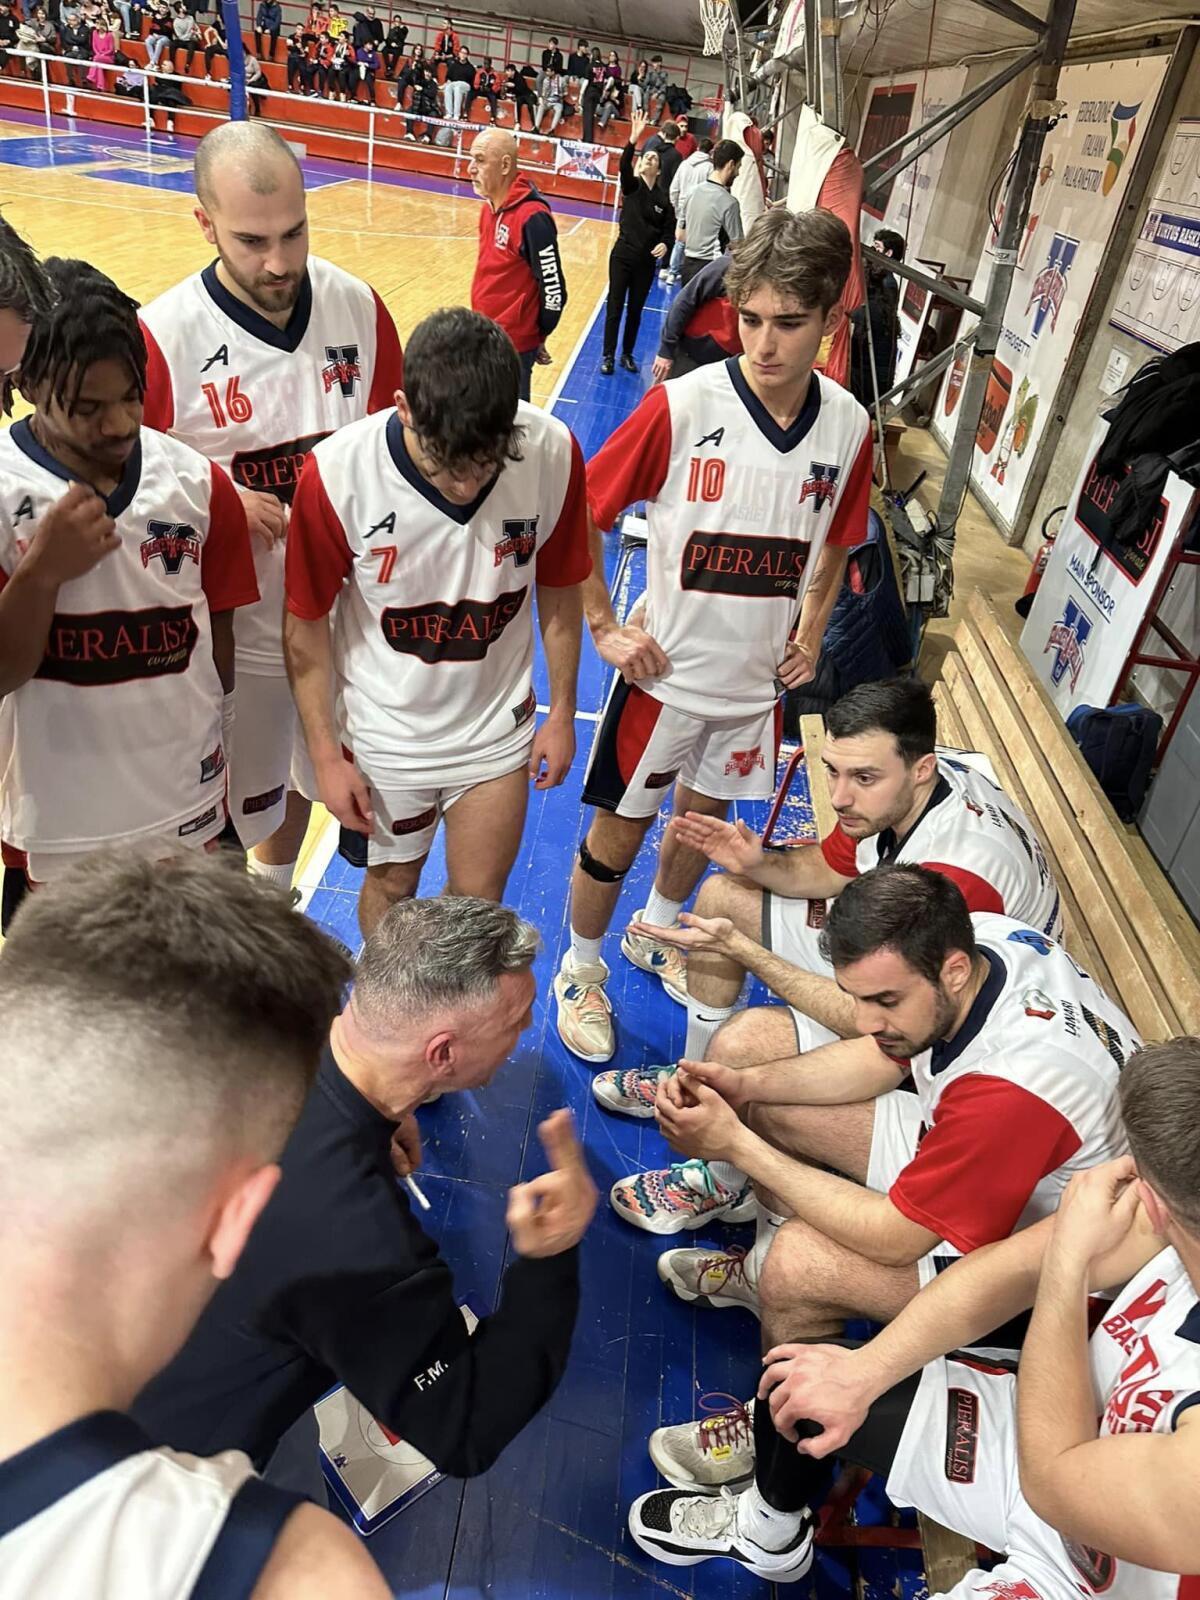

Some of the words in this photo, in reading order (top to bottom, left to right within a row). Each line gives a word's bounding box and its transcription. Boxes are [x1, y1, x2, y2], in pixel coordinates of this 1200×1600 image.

[539, 244, 562, 303] VIRTUS
[201, 375, 253, 429] 16
[687, 457, 726, 503] 10
[371, 544, 398, 584] 7
[1069, 555, 1087, 581] MAIN
[1083, 576, 1115, 617] SPONSOR
[414, 1360, 449, 1391] F.M.
[953, 1393, 973, 1480] PIERALISI
